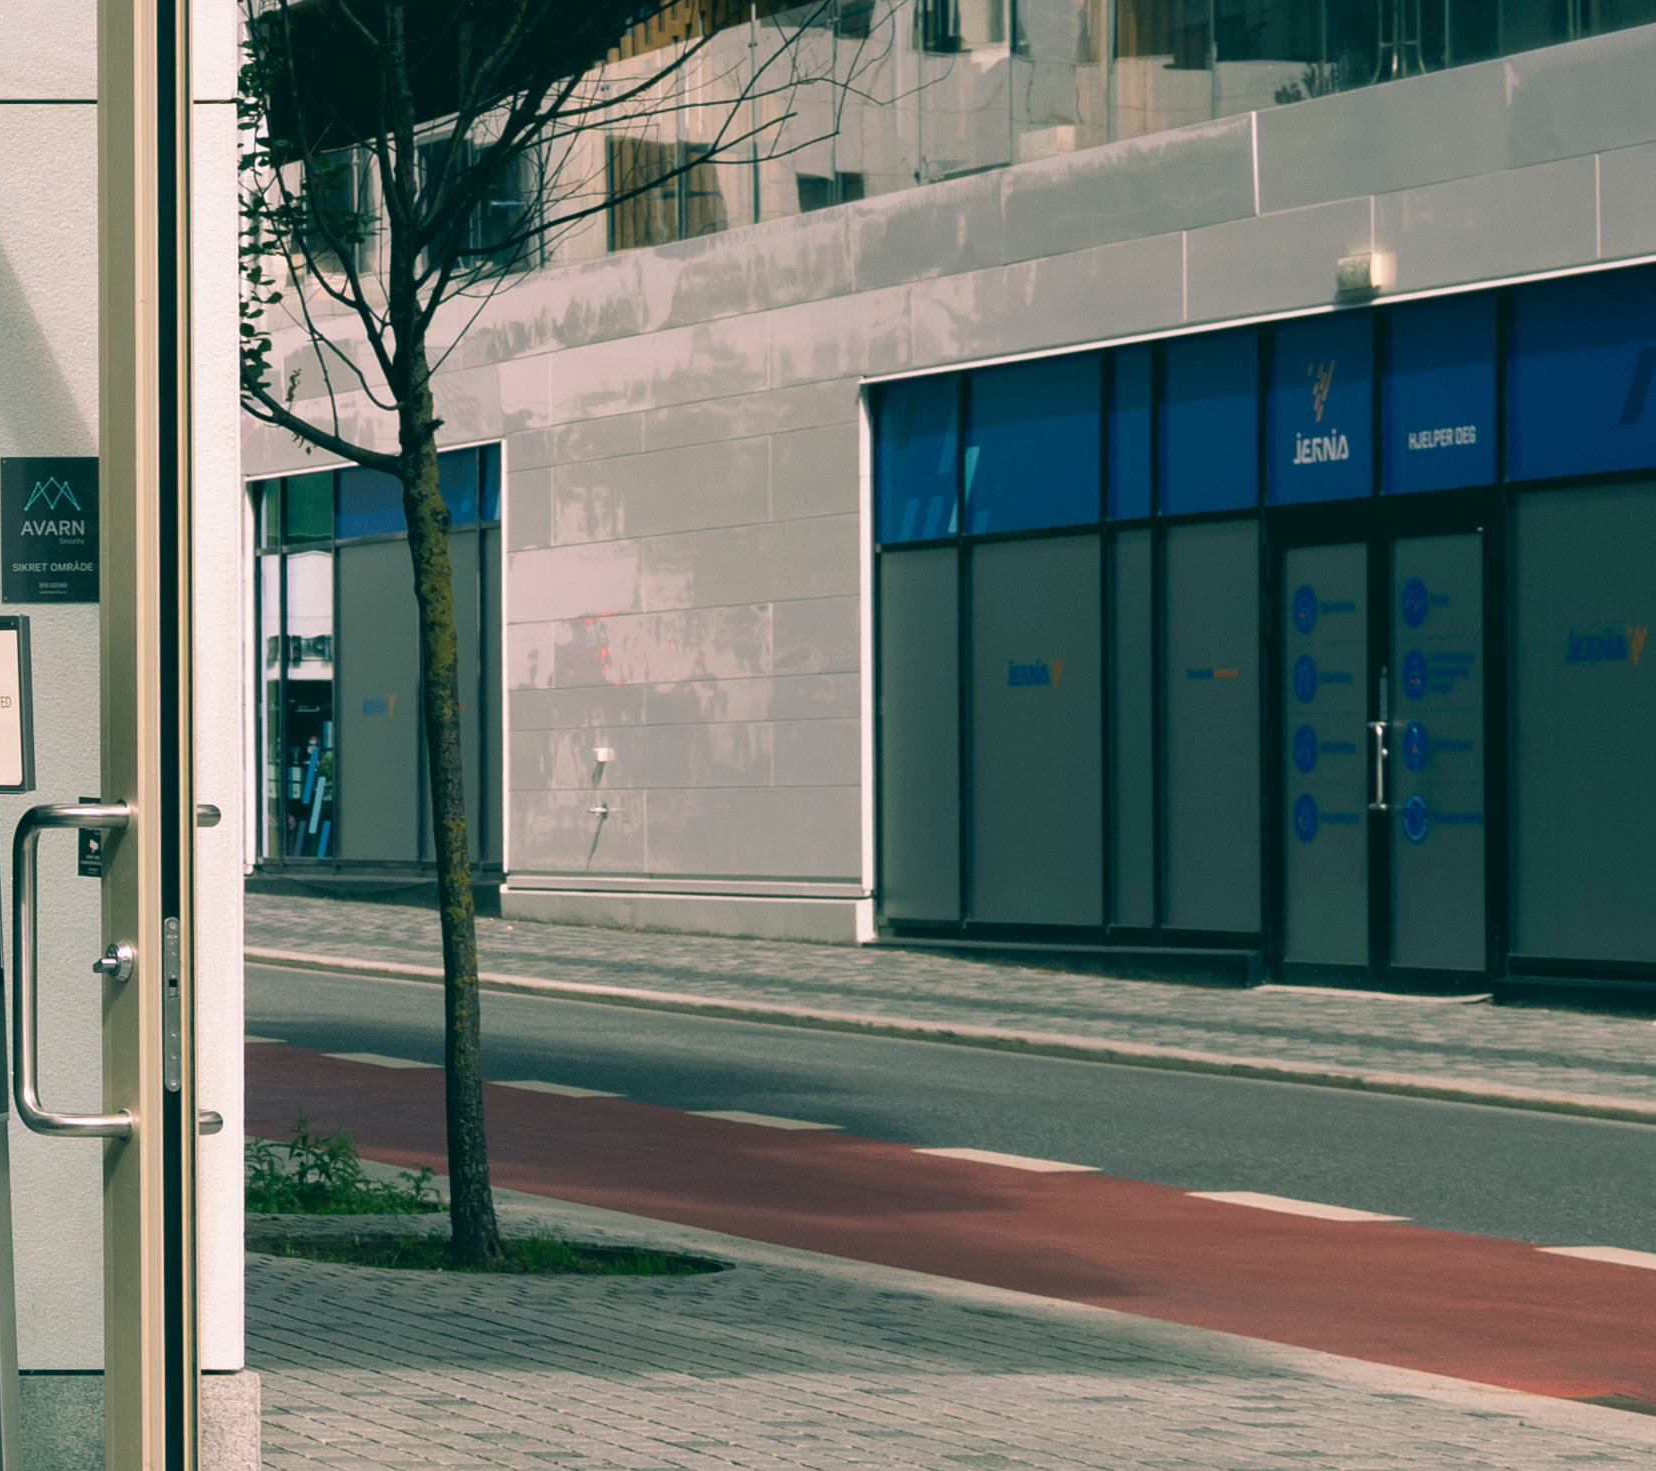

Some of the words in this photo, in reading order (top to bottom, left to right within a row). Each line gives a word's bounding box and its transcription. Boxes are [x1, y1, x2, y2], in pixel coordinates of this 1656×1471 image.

[1408, 428, 1453, 450] HJELPER
[1455, 426, 1476, 445] DEG
[20, 520, 85, 536] AVARN
[12, 562, 48, 572] SIKRET
[50, 560, 94, 572] OMRÅDE
